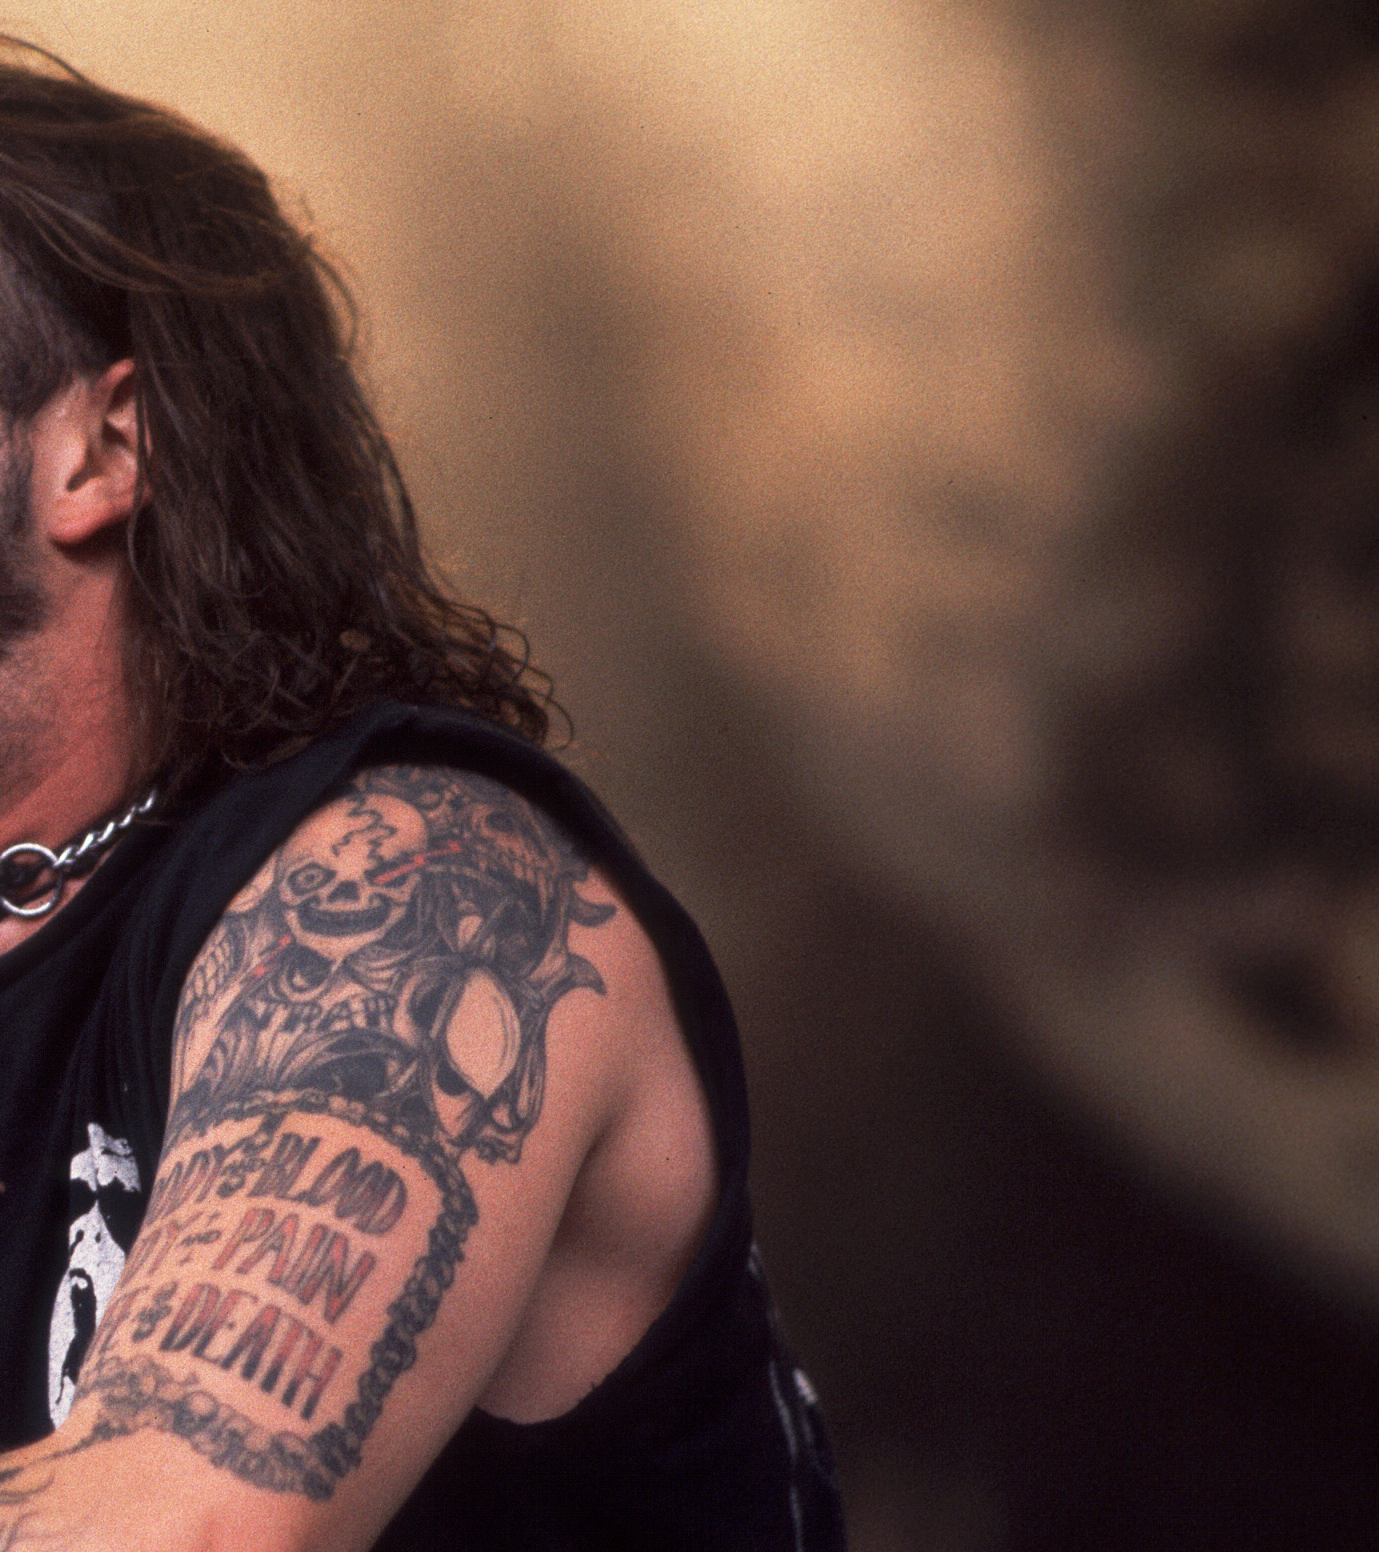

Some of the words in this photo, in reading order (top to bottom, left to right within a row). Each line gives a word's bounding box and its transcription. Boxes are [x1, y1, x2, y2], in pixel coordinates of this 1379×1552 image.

[248, 1132, 408, 1236] BLOOD
[211, 1207, 377, 1324] PAIN
[159, 1282, 343, 1421] DEATH
